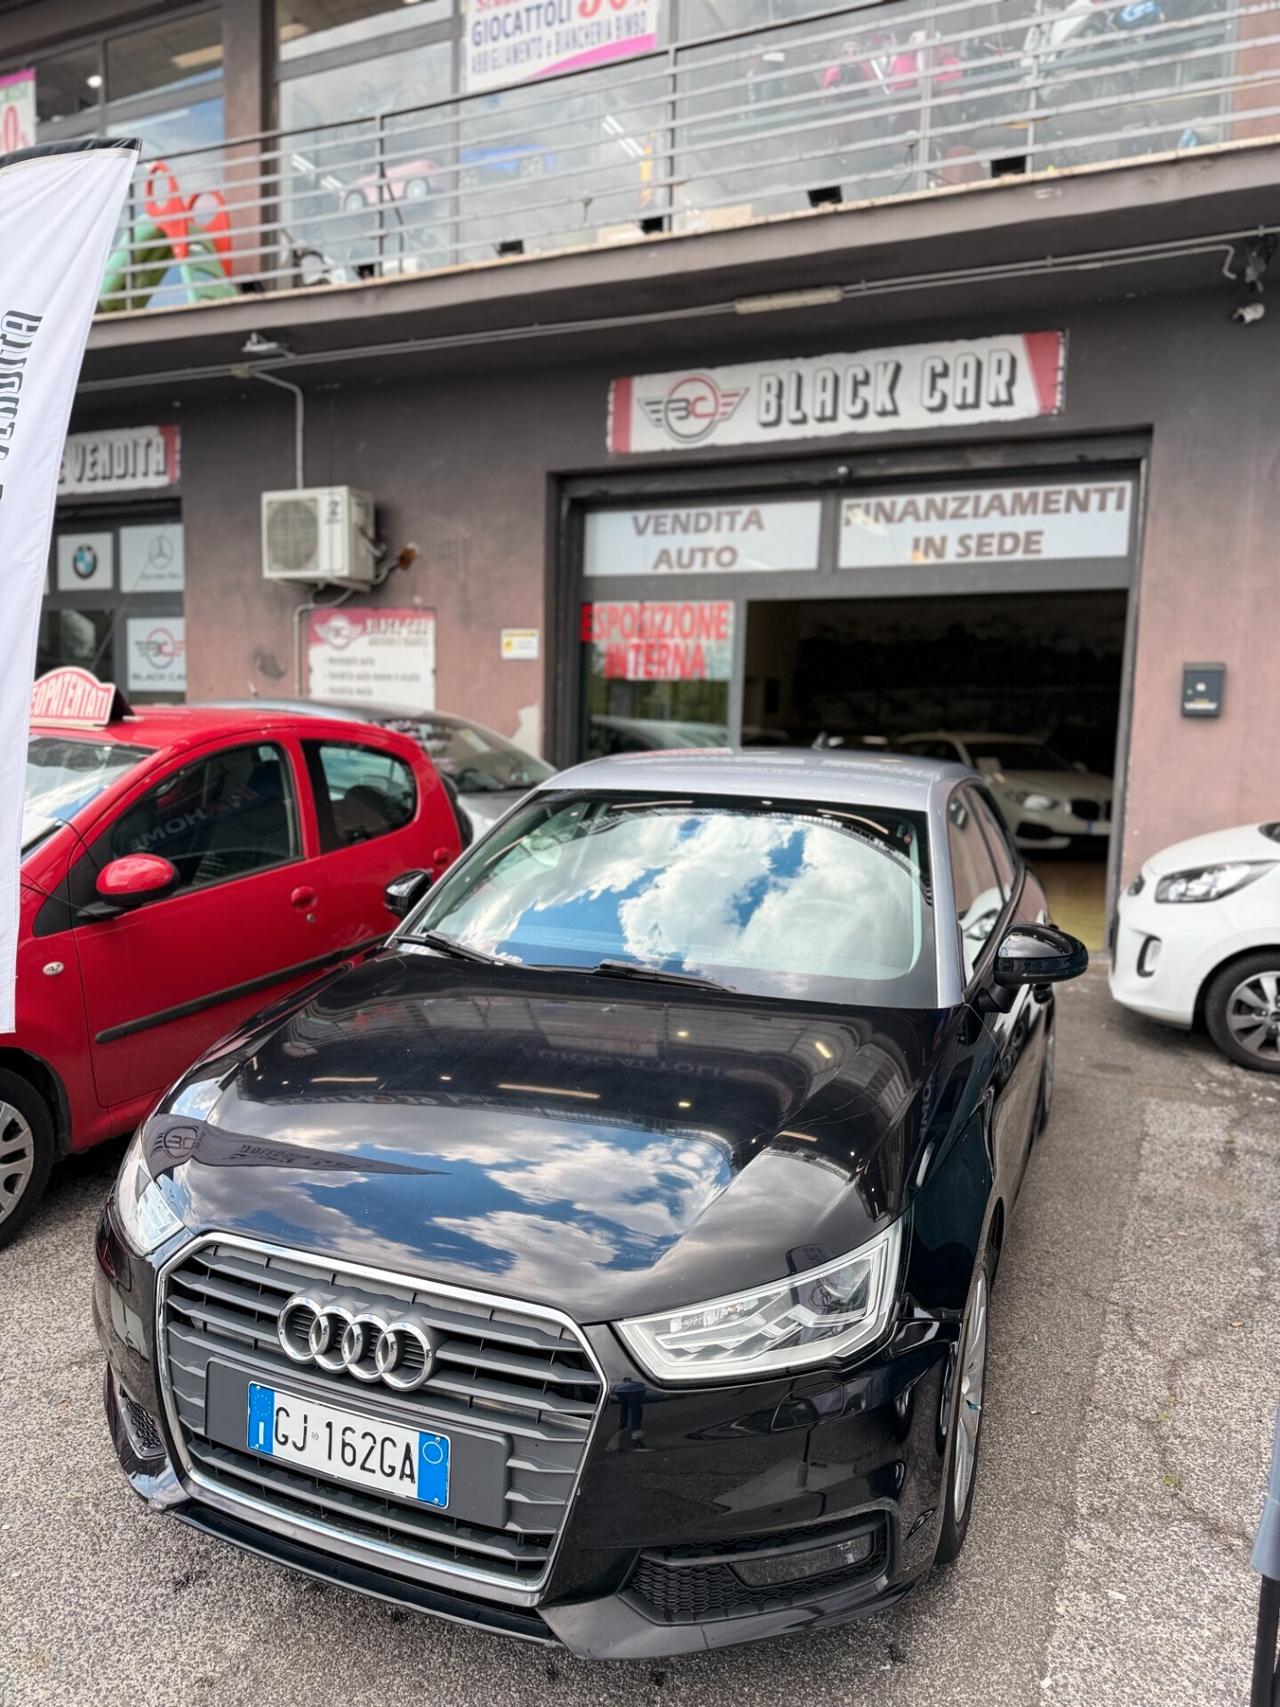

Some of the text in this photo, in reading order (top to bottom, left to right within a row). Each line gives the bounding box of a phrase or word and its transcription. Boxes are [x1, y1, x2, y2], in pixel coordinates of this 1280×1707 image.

[471, 0, 572, 47] GIOCATTOLI
[0, 310, 43, 460] DITA
[757, 360, 902, 428] BLACK
[921, 349, 1017, 413] CAR
[68, 437, 167, 482] VENDITA
[632, 508, 765, 536] VENDITA
[845, 486, 1127, 526] FINANZIAMENTI
[652, 545, 738, 571] AUTO
[911, 530, 1044, 561] IN SEDE
[580, 602, 730, 642] ESPOSIZIONE
[604, 643, 706, 680] INTERNA
[31, 672, 110, 718] EOPATENTATI
